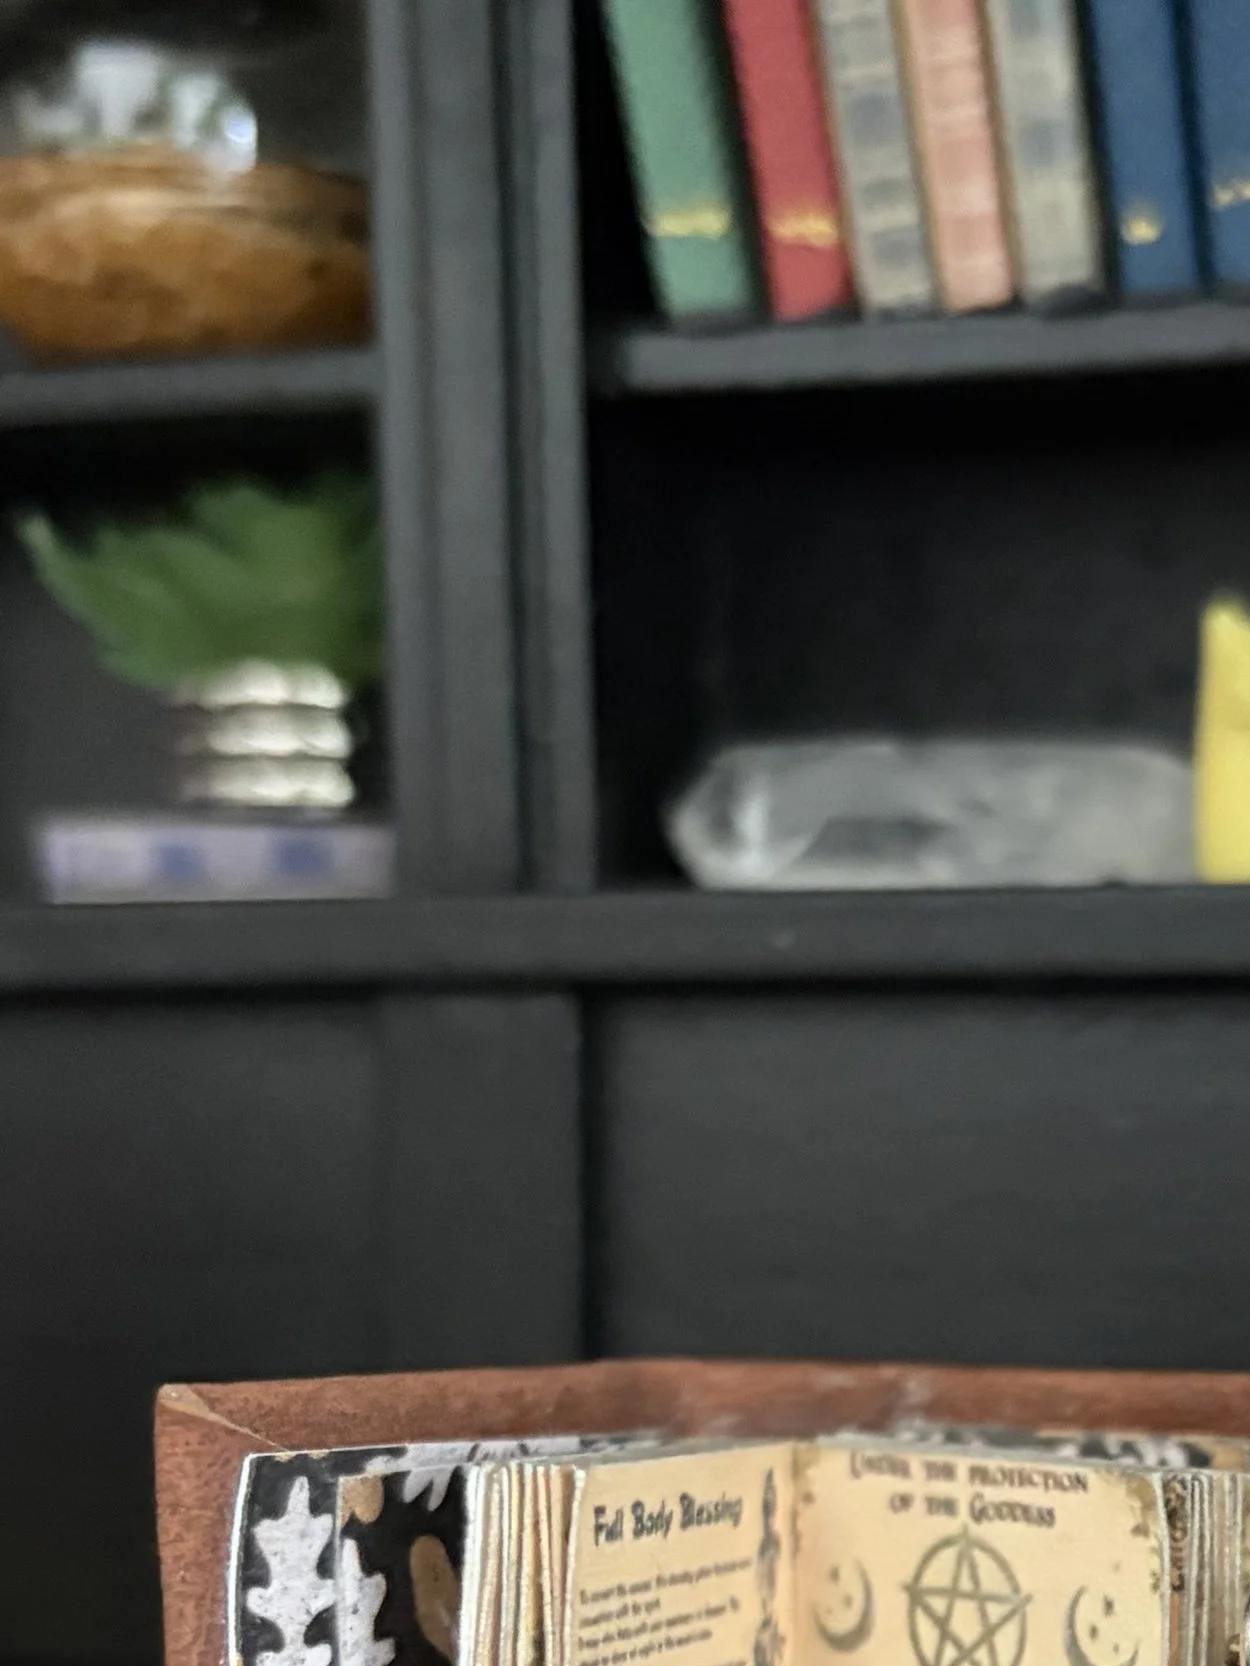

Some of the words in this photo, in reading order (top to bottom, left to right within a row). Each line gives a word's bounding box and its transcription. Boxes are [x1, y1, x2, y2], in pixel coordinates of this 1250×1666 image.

[594, 1505, 624, 1547] Full
[631, 1500, 673, 1540] Body
[679, 1492, 743, 1531] Blessing
